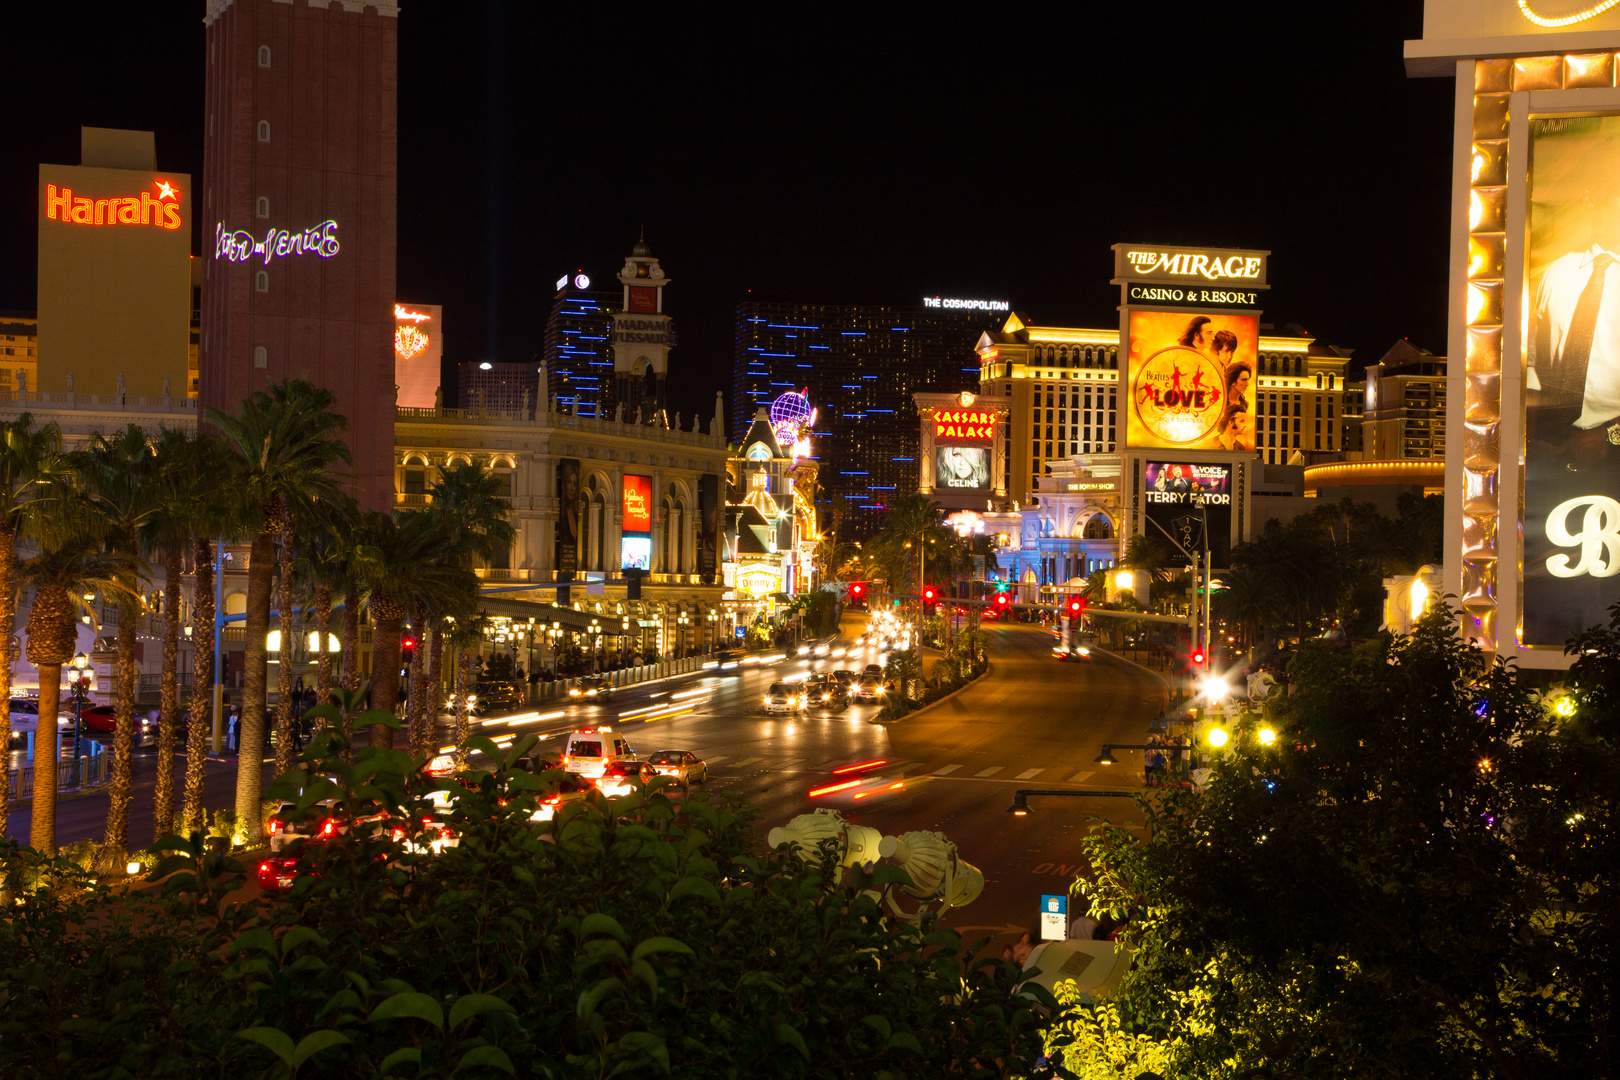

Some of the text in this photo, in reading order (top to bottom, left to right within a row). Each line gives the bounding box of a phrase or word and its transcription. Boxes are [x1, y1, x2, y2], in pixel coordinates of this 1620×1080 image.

[1127, 251, 1262, 280] THE MIRAGE
[1131, 287, 1258, 305] CASINO & RESORT
[923, 297, 1009, 311] THE COSMOPOLITAN
[1154, 389, 1206, 408] LOVE
[933, 411, 997, 425] CAESARS
[936, 425, 993, 438] PALACE
[1199, 466, 1222, 474] VOICE
[948, 479, 979, 488] CELINE
[1145, 491, 1230, 505] TERRY FATOR
[742, 578, 777, 589] Denny's
[1031, 862, 1085, 878] ONL
